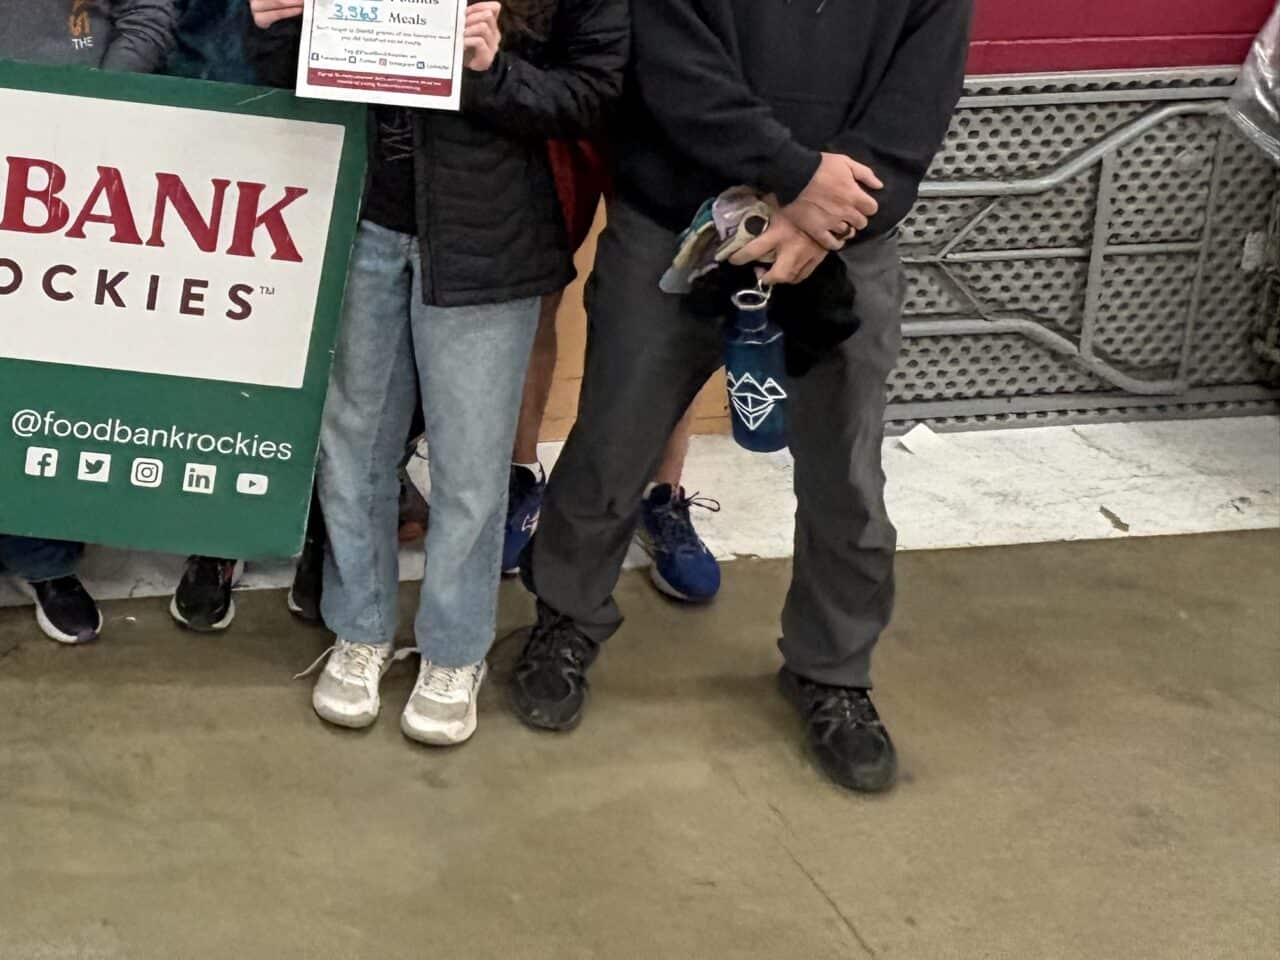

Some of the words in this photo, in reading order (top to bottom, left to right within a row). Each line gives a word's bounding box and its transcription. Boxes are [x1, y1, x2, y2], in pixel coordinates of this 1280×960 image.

[388, 12, 427, 26] Meals
[72, 37, 94, 50] THE
[11, 409, 294, 461] @foodbankrockies
